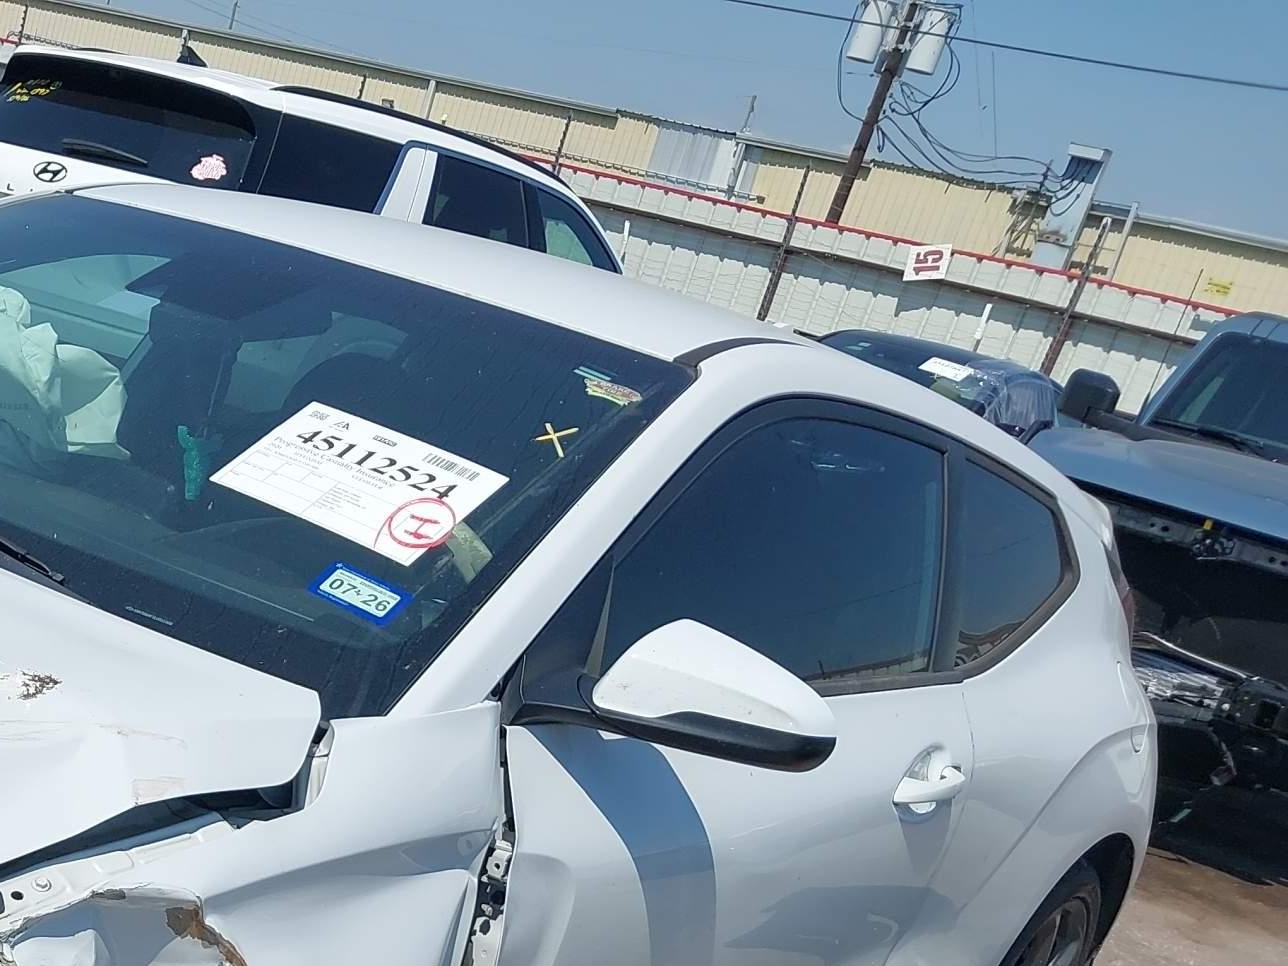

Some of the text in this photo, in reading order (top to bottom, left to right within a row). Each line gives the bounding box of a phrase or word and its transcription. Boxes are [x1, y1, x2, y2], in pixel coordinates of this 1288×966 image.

[912, 249, 944, 276] 15
[296, 430, 458, 500] 45112524
[328, 578, 358, 595] 07
[359, 593, 391, 612] 26
